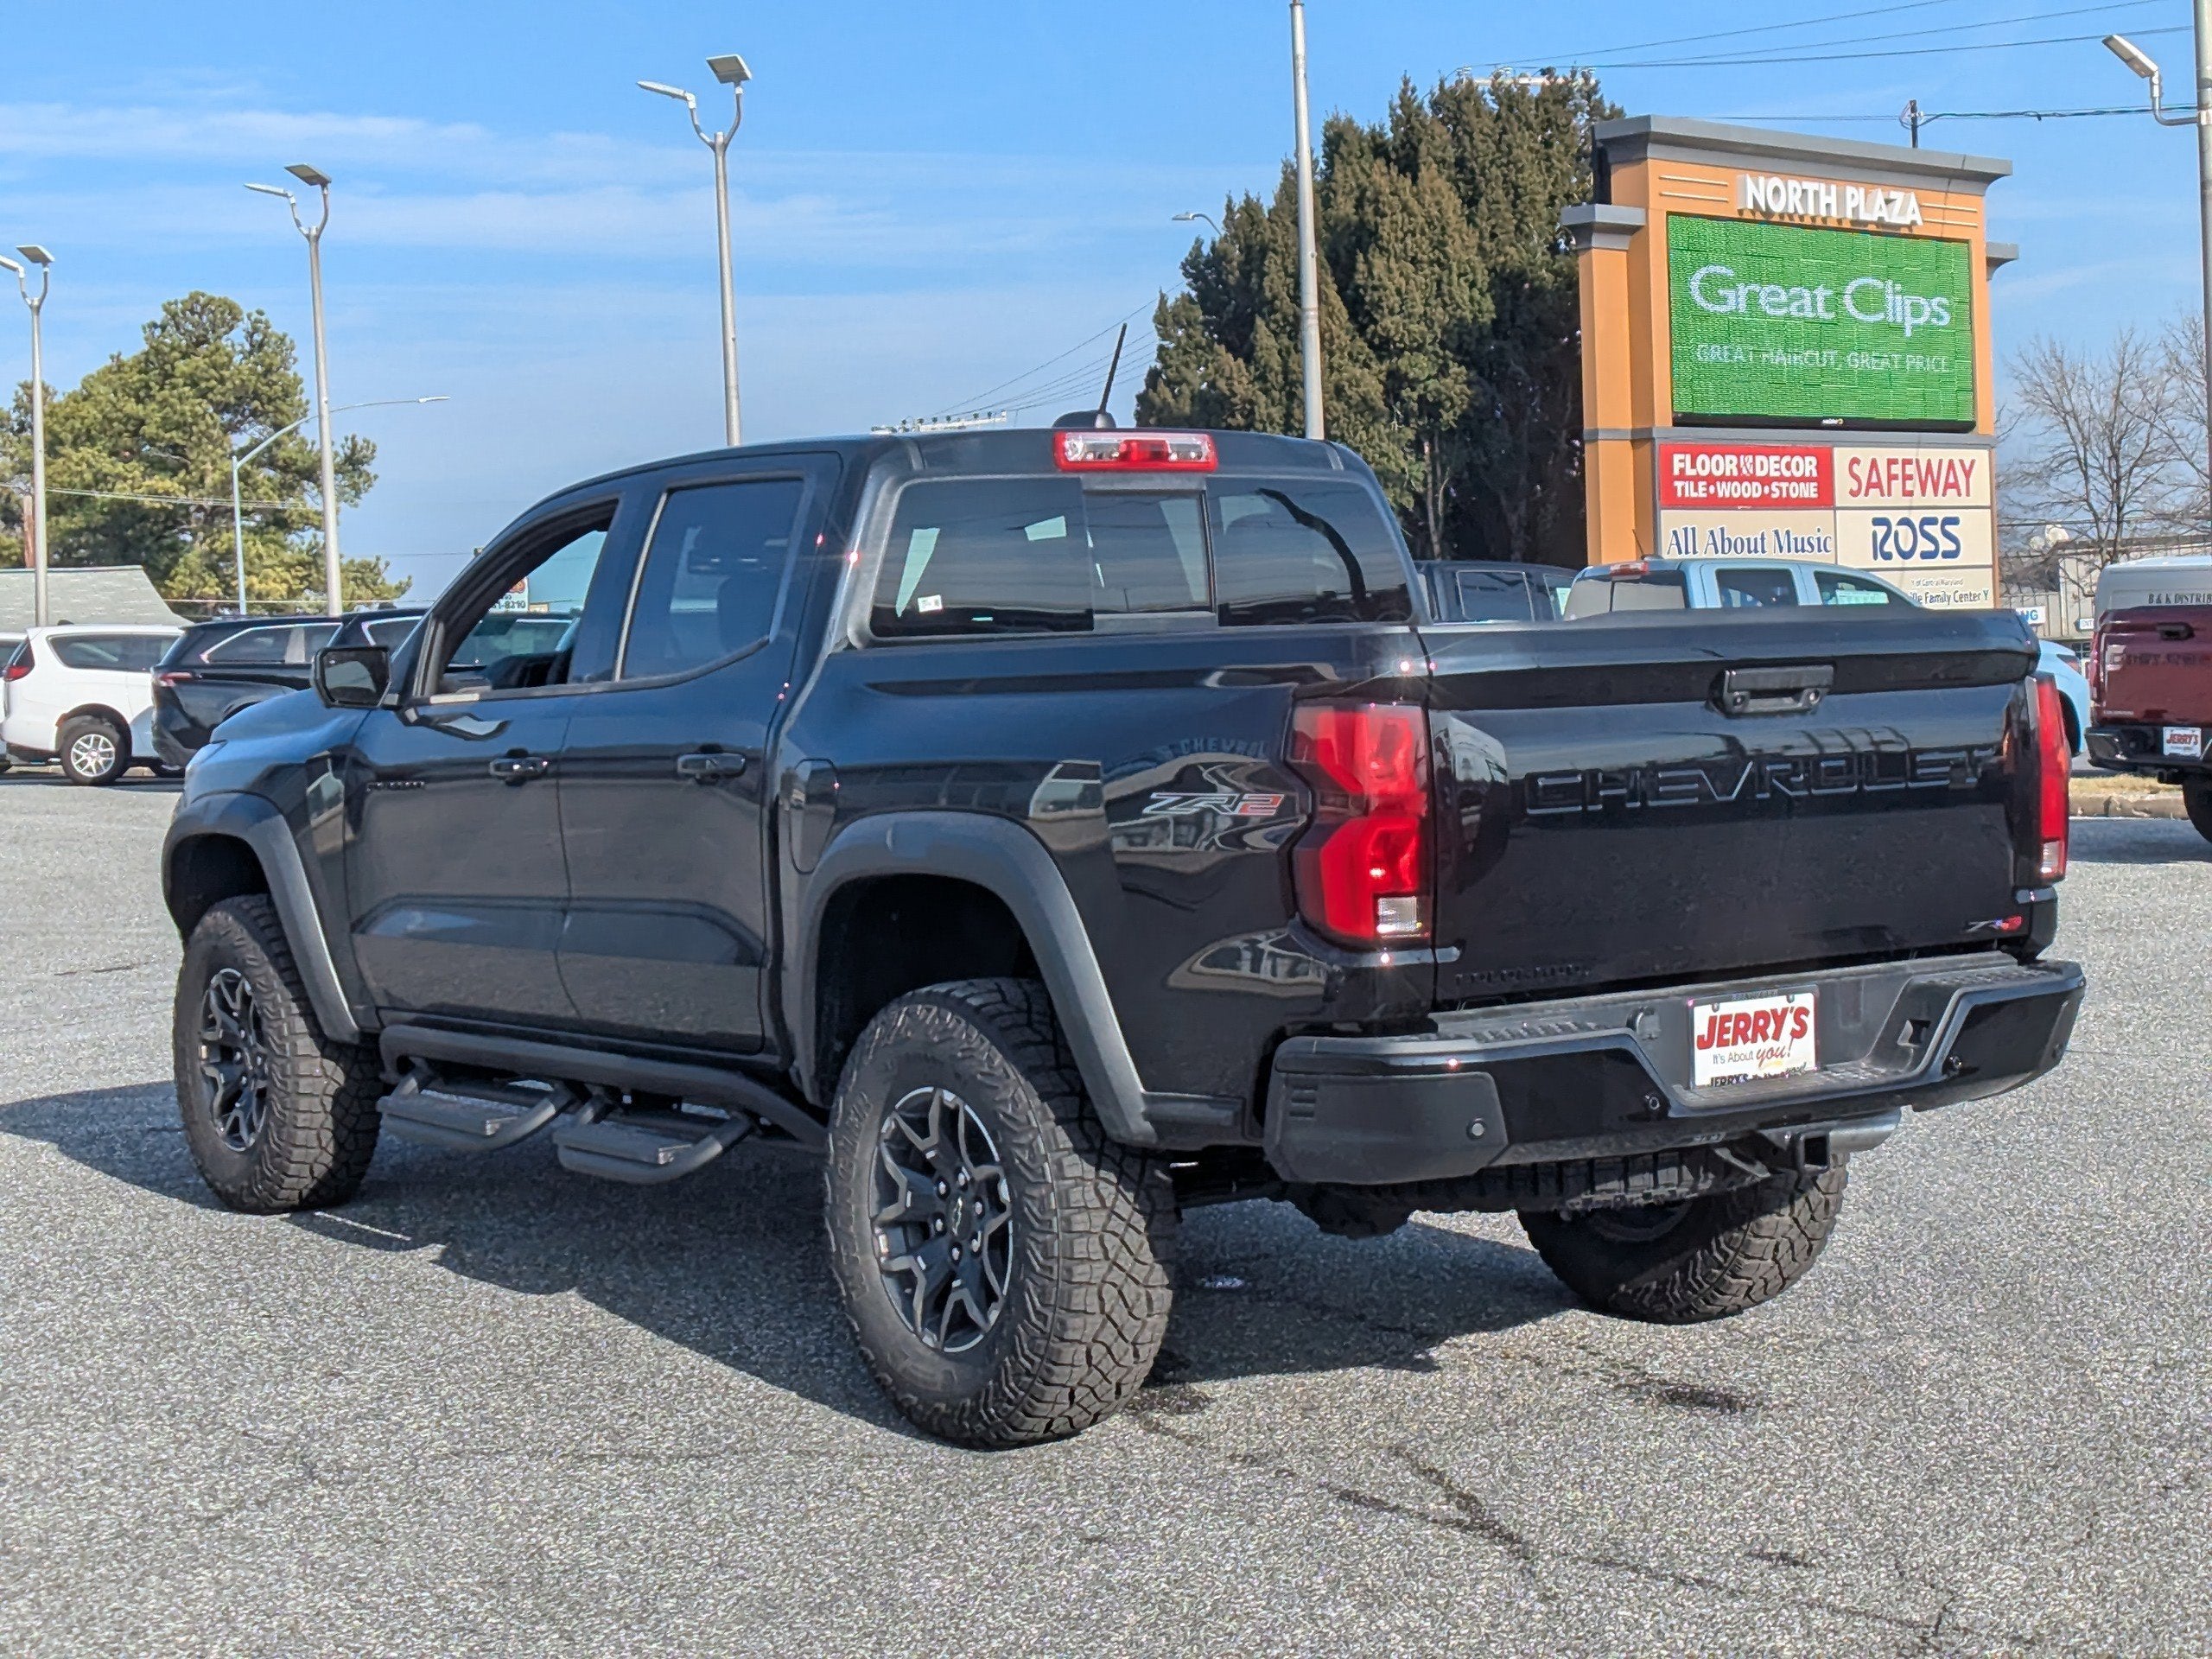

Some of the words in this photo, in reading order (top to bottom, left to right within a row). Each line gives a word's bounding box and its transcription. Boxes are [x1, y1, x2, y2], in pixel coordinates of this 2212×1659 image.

[1741, 175, 1837, 219] NORTH
[1845, 185, 1923, 226] PLAZA
[1688, 264, 1837, 320] Great
[1842, 276, 1951, 337] Clips
[1696, 344, 1754, 363] GREAT
[1847, 352, 1901, 370] GREAT
[1906, 354, 1949, 372] PRICE
[1674, 480, 1707, 498] TILE
[1718, 481, 1762, 499] WOOD
[1770, 481, 1818, 499] STONE
[1848, 456, 1976, 497] SAFEWAY
[1667, 526, 1698, 556] All
[1704, 528, 1766, 556] About
[1772, 528, 1832, 555] Music
[1872, 516, 1961, 561] ROSS
[1924, 590, 1951, 606] Family
[1953, 590, 1981, 603] Center
[1525, 748, 1994, 815] CHEVROLET
[1141, 791, 1285, 816] ZR2
[1696, 1006, 1810, 1050] JERRY'S
[1713, 1052, 1726, 1065] It's
[1727, 1051, 1754, 1064] About
[1756, 1037, 1794, 1070] you!
